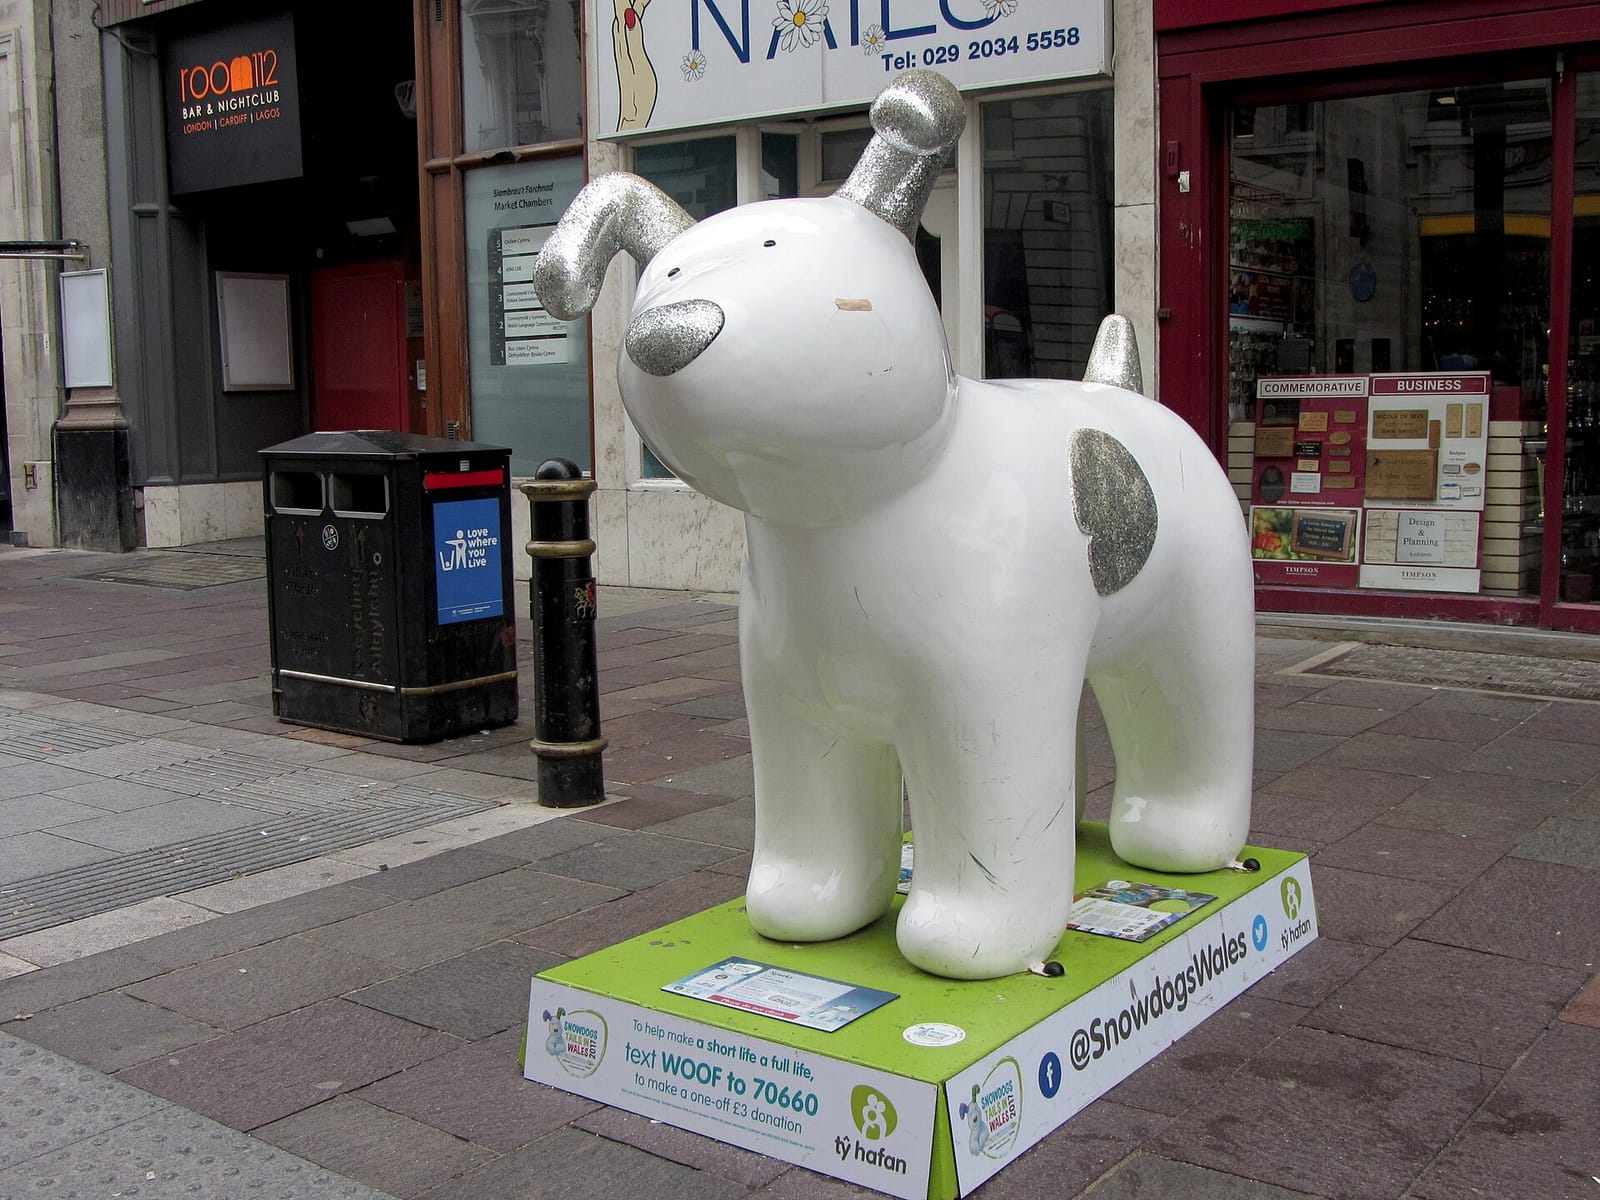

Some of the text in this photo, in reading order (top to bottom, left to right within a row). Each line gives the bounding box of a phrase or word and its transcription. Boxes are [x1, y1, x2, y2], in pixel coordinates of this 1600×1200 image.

[881, 27, 1080, 72] Tel: 029 2034 5558
[182, 90, 280, 120] BAR & NIGHTCLUB
[183, 108, 280, 134] LONDON CARDIFF LAGOS
[525, 182, 554, 194] Farchnad
[494, 198, 553, 211] Market Chambers
[496, 240, 501, 249] 5
[498, 294, 503, 302] 3
[497, 321, 503, 329] 2
[500, 350, 504, 358] 1
[1264, 382, 1361, 393] COMMEMORATIVE
[1397, 380, 1461, 391] BUSINESS
[1409, 517, 1435, 528] Design
[468, 537, 498, 548] where
[1403, 537, 1438, 547] Planning
[1289, 919, 1312, 944] hafan
[1069, 930, 1247, 1072] @SnowdogsWales
[563, 1021, 598, 1040] SNOWDOGS
[565, 1032, 590, 1046] TAILS IN
[567, 1043, 589, 1058] WALES
[589, 1039, 597, 1060] 2017
[632, 1018, 814, 1082] To help make a short life a full life,
[625, 1041, 657, 1070] text
[661, 1051, 723, 1088] WOOF
[727, 1071, 746, 1095] to
[753, 1077, 819, 1116] 70660
[635, 1072, 645, 1086] to
[647, 1078, 678, 1096] make
[680, 1088, 688, 1099] a
[690, 1091, 731, 1112] one-off
[732, 1101, 748, 1117] £3
[751, 1107, 802, 1134] donation
[981, 1079, 1014, 1110] SNOWDOGS
[984, 1096, 1009, 1120] TAILS IN
[1007, 1094, 1017, 1119] 2017
[988, 1110, 1010, 1133] WALES
[854, 1140, 907, 1175] hafan
